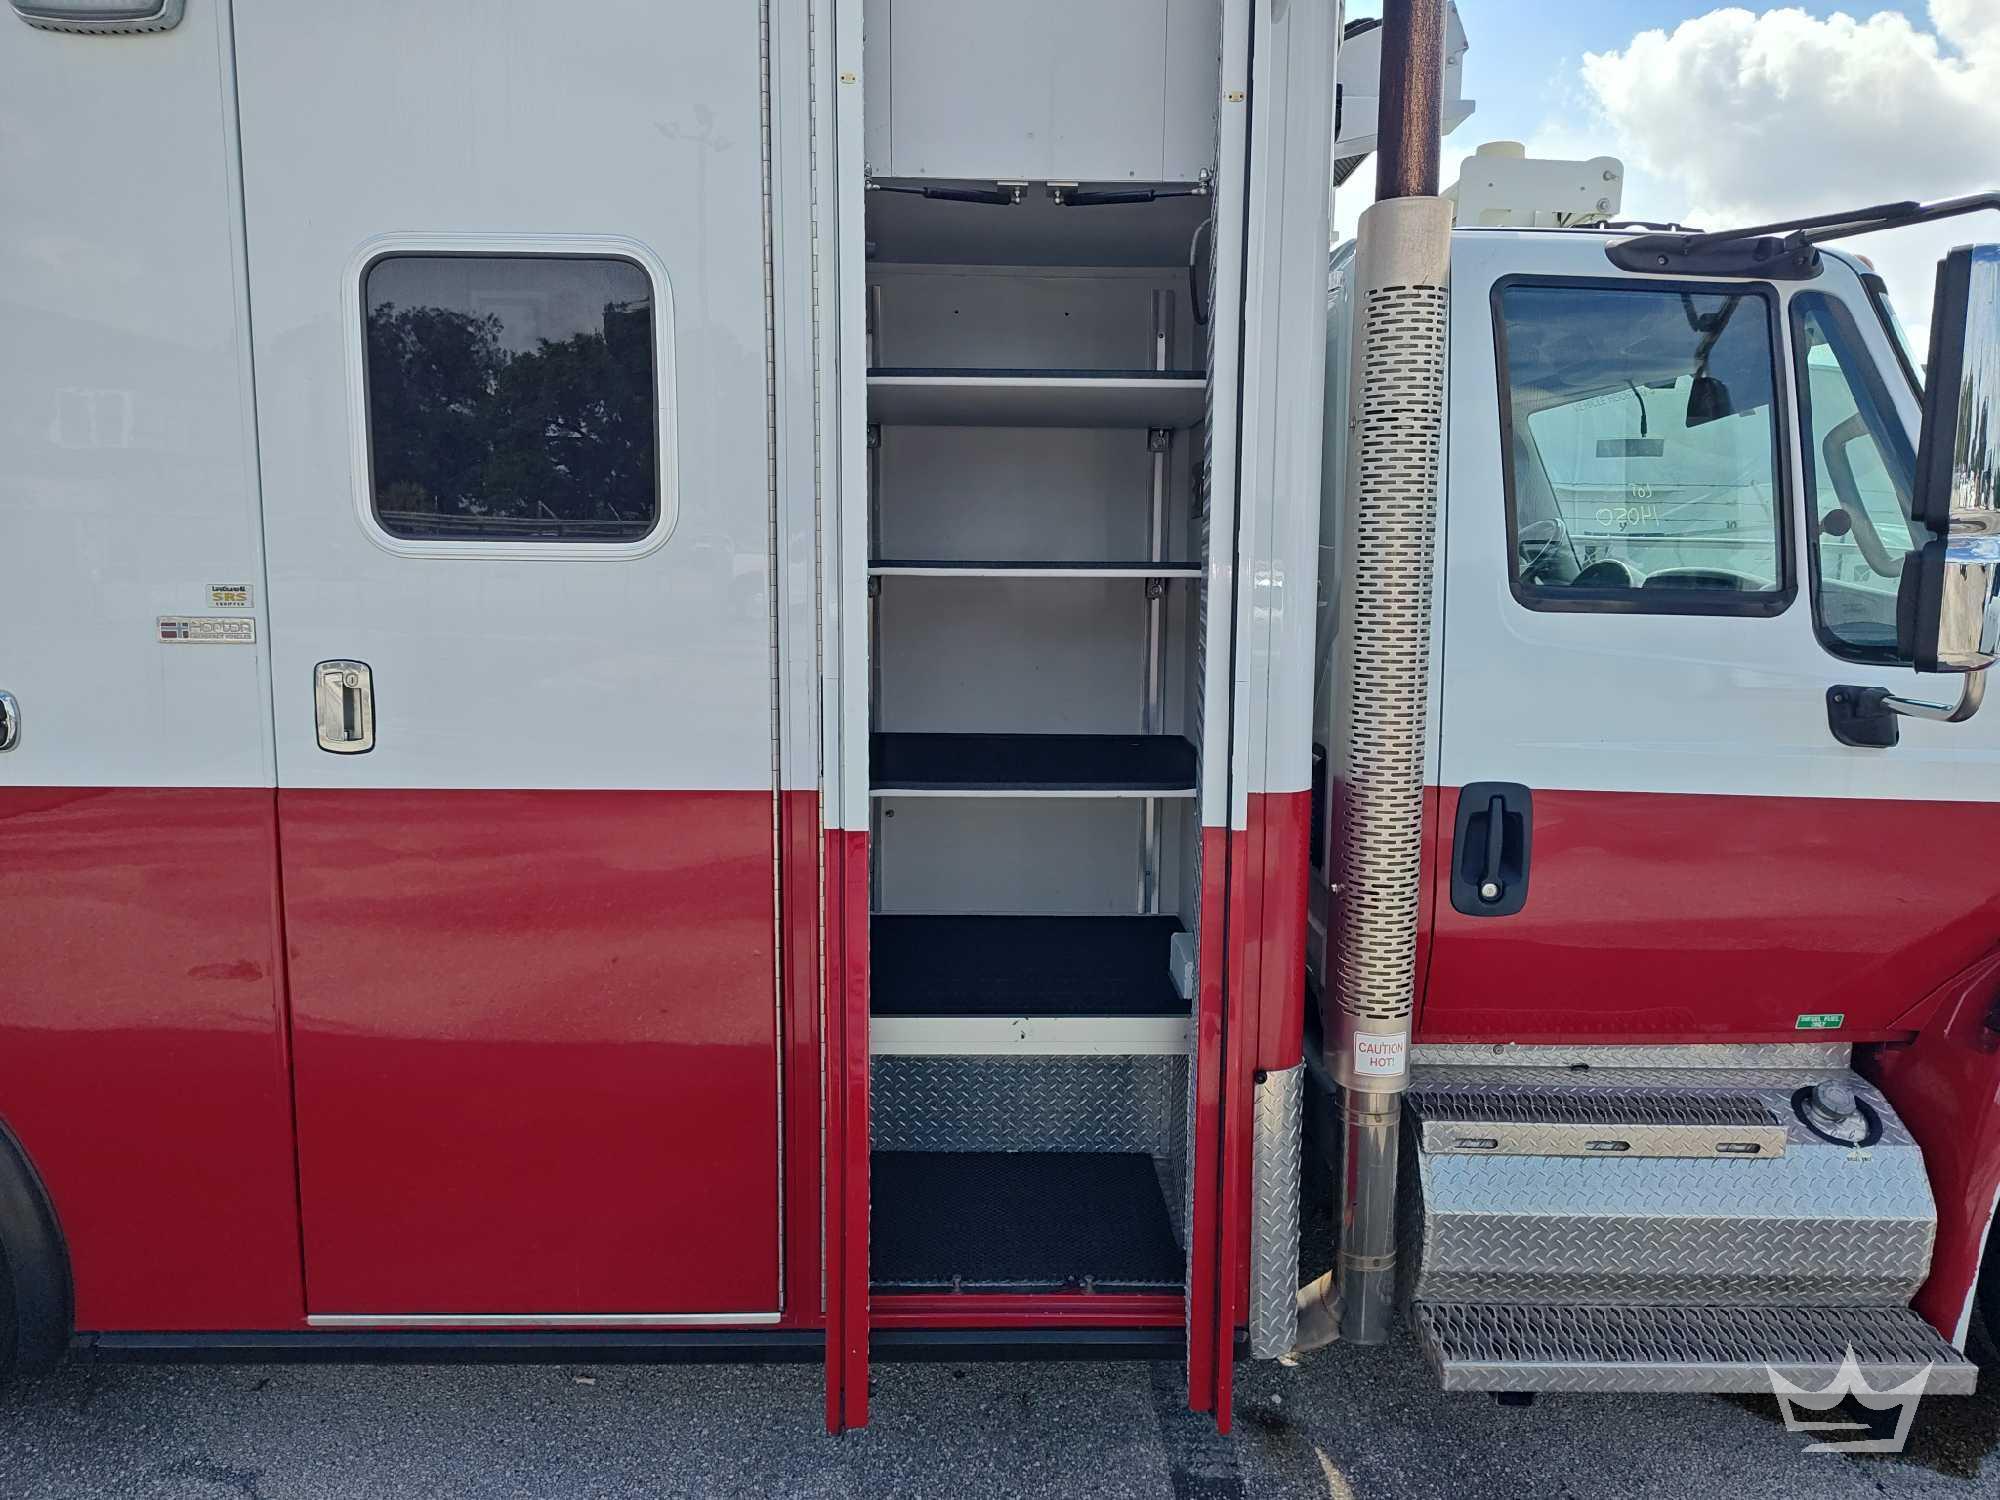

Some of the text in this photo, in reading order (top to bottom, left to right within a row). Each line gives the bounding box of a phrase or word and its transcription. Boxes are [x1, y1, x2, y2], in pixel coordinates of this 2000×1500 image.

[211, 592, 247, 601] SRS
[1358, 1042, 1403, 1054] CAUTION
[1369, 1056, 1395, 1067] HOT!
